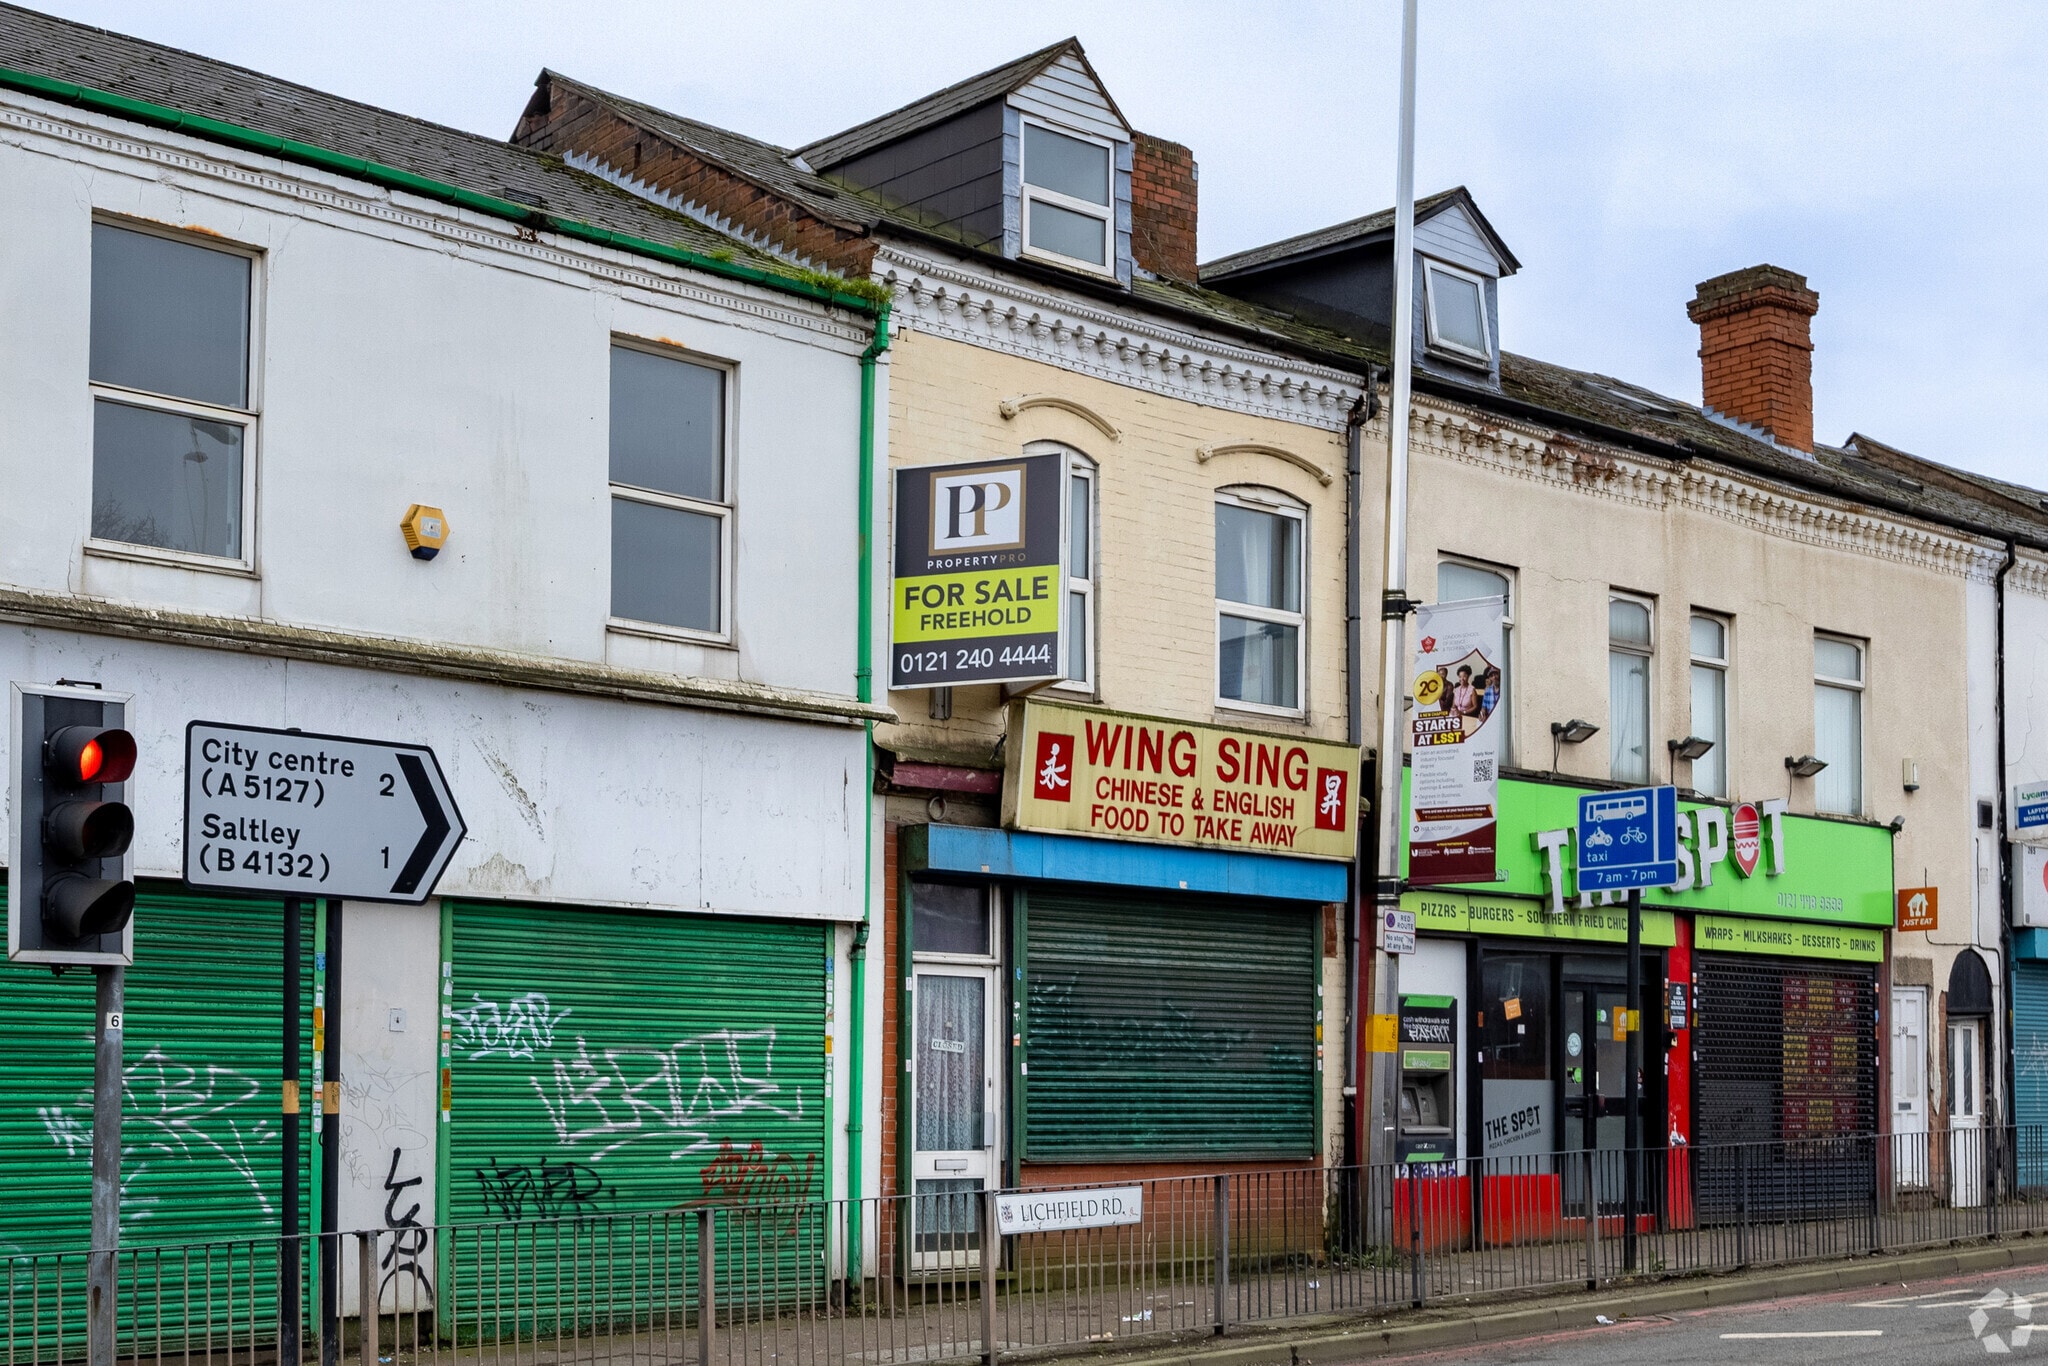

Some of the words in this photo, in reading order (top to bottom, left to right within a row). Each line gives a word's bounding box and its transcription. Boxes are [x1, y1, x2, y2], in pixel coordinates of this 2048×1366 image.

[905, 583, 965, 610] FOR
[974, 576, 1049, 604] SALE
[920, 607, 1032, 631] FREEHOLD
[900, 651, 947, 673] 0121
[955, 647, 994, 669] 240
[999, 643, 1050, 667] 4444
[1415, 718, 1460, 732] STARTS
[1418, 734, 1432, 745] AT
[1433, 731, 1461, 744] LSST
[202, 739, 259, 770] City
[268, 751, 355, 777] centre
[1085, 719, 1197, 778] WING
[1215, 737, 1309, 792] SING
[379, 773, 395, 797] 2
[1095, 776, 1184, 808] CHINESE
[1191, 787, 1205, 811] &
[1213, 789, 1295, 820] ENGLISH
[202, 812, 301, 849] Saltley
[1091, 804, 1150, 833] FOOD
[1158, 811, 1185, 836] TO
[1194, 815, 1243, 842] TAKE
[1250, 822, 1298, 848] AWAY
[381, 847, 390, 869] 1
[1586, 850, 1608, 862] taxi
[1597, 873, 1604, 883] 7
[1605, 872, 1623, 883] am
[1631, 870, 1638, 880] 7
[1640, 870, 1657, 882] pm
[1777, 892, 1797, 909] 0121
[1397, 922, 1413, 930] ROUTE
[1400, 914, 1411, 922] RED
[1420, 902, 1457, 918] PIZZAS
[1469, 907, 1514, 922] BURGERS
[1578, 914, 1604, 929] FRIED
[1607, 916, 1644, 932] CHICN
[1902, 918, 1919, 927] JUST
[1920, 917, 1933, 926] EAT
[1705, 926, 1733, 940] WRAPS
[1743, 930, 1792, 945] MILKSHAKES
[1802, 935, 1841, 949] DESSERTS
[1850, 938, 1876, 952] DRINKS
[111, 1015, 120, 1027] 6
[932, 1040, 963, 1051] CLOSED
[1485, 1116, 1509, 1141] THE
[1020, 1199, 1098, 1222] LICHFIELD
[1102, 1197, 1126, 1215] RD.
